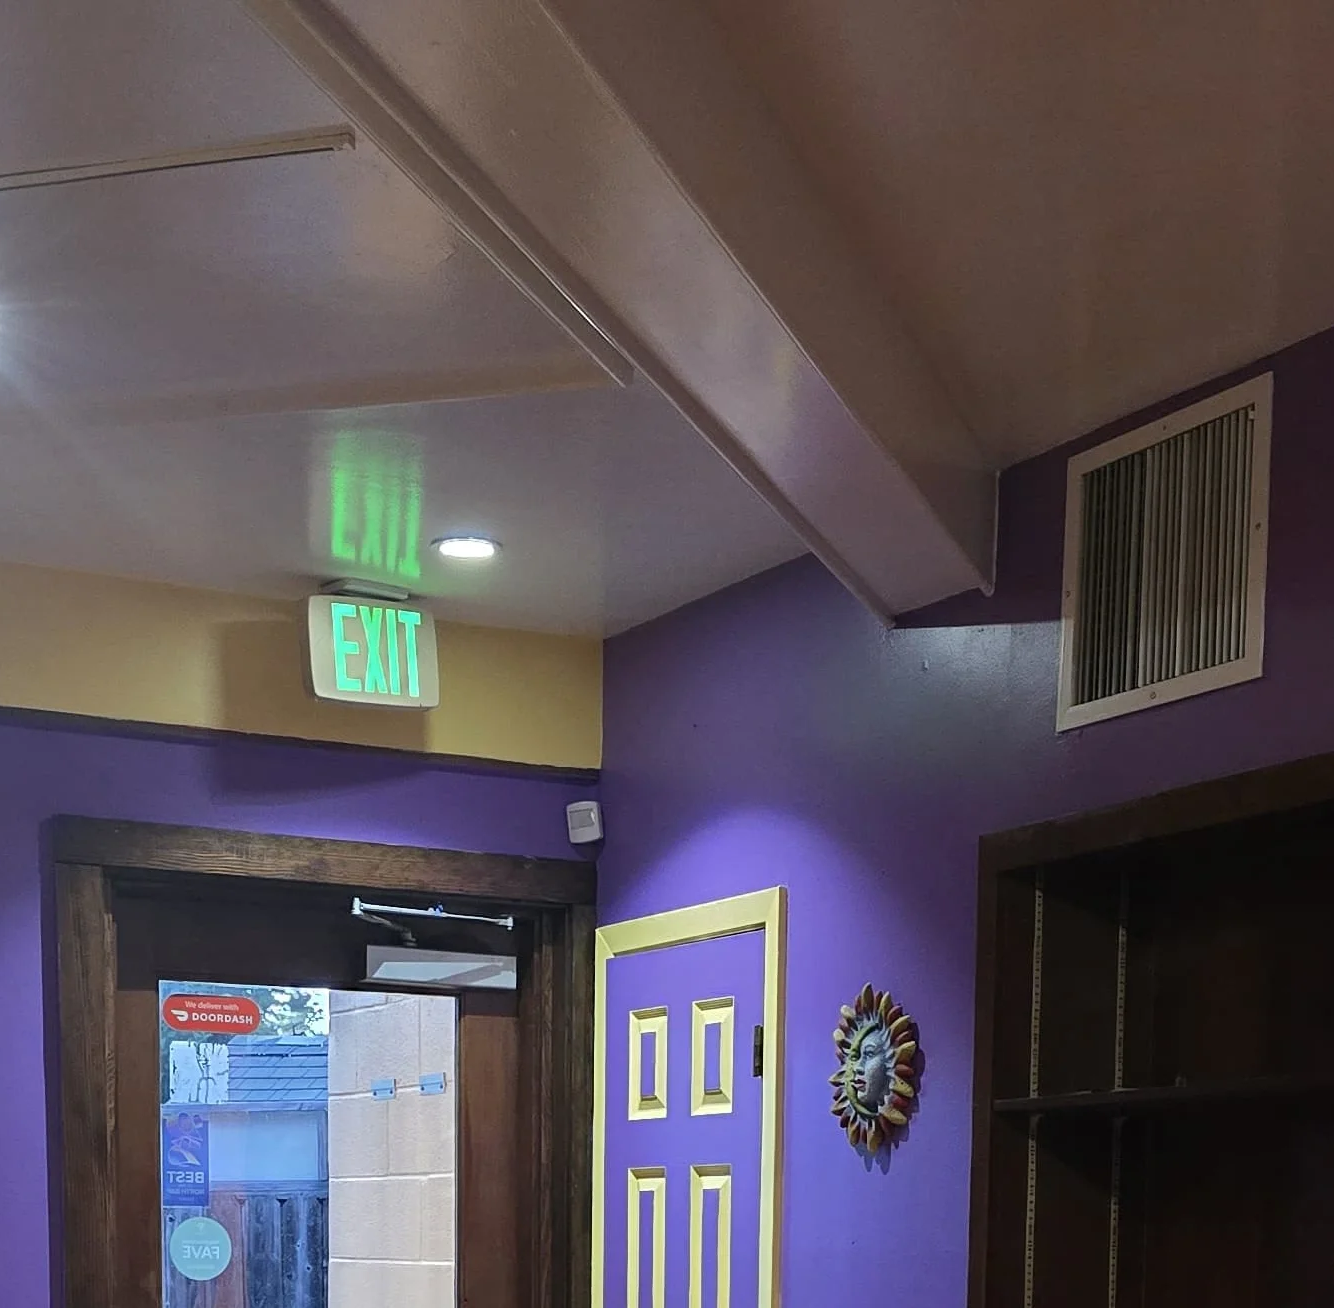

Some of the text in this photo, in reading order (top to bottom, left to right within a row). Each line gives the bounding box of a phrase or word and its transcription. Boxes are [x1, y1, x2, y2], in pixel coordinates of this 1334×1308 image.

[331, 602, 421, 698] EXIT
[185, 1001, 240, 1012] We deliver with
[192, 1012, 254, 1024] DOORDASH
